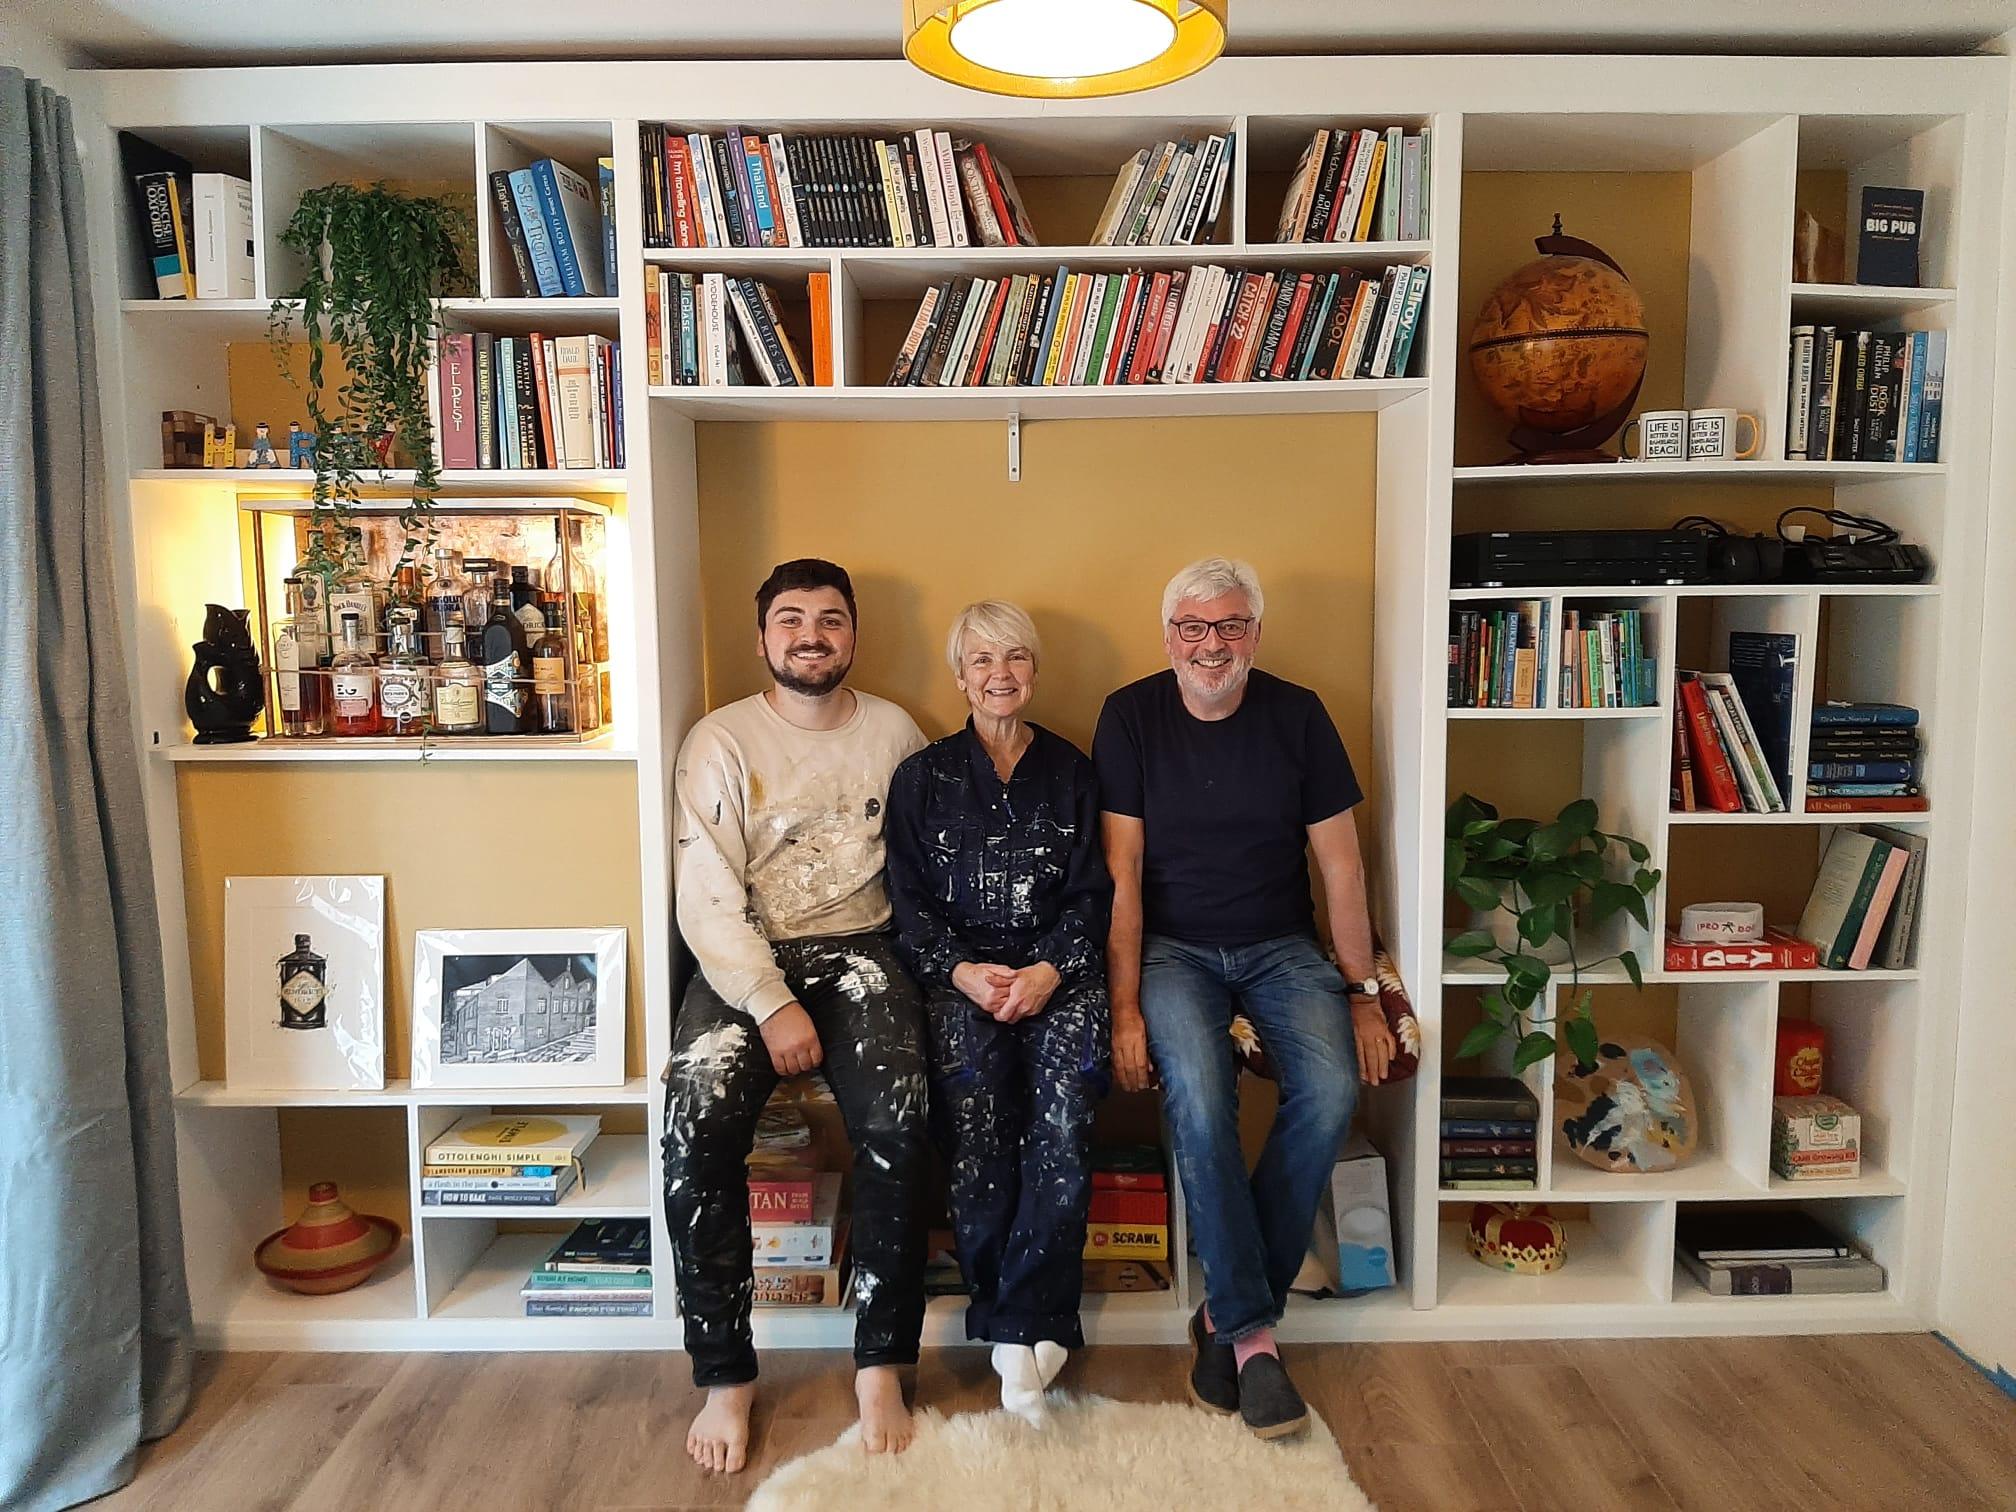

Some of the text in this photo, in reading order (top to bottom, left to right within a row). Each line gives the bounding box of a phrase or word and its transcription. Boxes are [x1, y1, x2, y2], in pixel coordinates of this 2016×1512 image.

[1211, 142, 1220, 154] Anne
[751, 161, 767, 209] Thailand
[941, 148, 958, 206] William Boyd
[1198, 172, 1210, 186] SPOOL
[675, 176, 687, 217] travelling
[1192, 194, 1202, 206] BLUE
[1322, 200, 1331, 219] OUT
[146, 188, 164, 237] OXFORD
[157, 186, 173, 237] CONCISE
[1187, 207, 1198, 226] THREAD
[1311, 193, 1326, 229] BOUNDS
[517, 184, 554, 276] SEA TROLLS
[552, 219, 565, 245] BOYD
[679, 220, 689, 247] alone
[1865, 218, 1916, 235] BIG PUB
[561, 248, 576, 288] WILLIAM
[1042, 286, 1050, 297] THE
[1397, 272, 1408, 296] PAPER
[682, 297, 690, 333] CHASE
[709, 278, 719, 332] WODEHOUSE
[1161, 292, 1179, 332] LIONBOY
[1230, 282, 1258, 340] CATCH-22
[1391, 297, 1403, 316] LION
[1400, 279, 1426, 330] Ellroy
[742, 281, 779, 357] BURIAL RITES
[904, 289, 938, 355] WILLIAM BOYD
[938, 292, 964, 355] JOHN STEINBECK
[1328, 297, 1353, 347] WOOL
[561, 346, 580, 355] ROALD
[1803, 340, 1811, 364] MARTIN
[1874, 339, 1884, 379] PULLMAN
[1881, 345, 1891, 373] PHILIP
[522, 352, 530, 396] SEBASTIAN
[1824, 349, 1833, 381] PRATCHETT
[450, 363, 463, 432] ELDEST
[479, 351, 491, 445] IAIN BANKS TRANSITION
[1869, 387, 1879, 412] DUST
[1877, 385, 1888, 417] BOOK
[1650, 422, 1679, 432] LIFE IS
[1692, 421, 1719, 430] LIFE IS
[203, 420, 396, 469] HARY
[529, 447, 535, 456] IN
[1650, 446, 1679, 454] BEACH
[1690, 444, 1719, 453] BEACH
[1824, 802, 1851, 810] Smith
[1702, 950, 1773, 968] DIY
[438, 1153, 541, 1161] OTTOLENGHI SIMPLE
[434, 1180, 451, 1188] flash
[462, 1180, 473, 1188] the
[460, 1193, 468, 1201] TO
[469, 1193, 486, 1201] BAKE
[750, 1192, 787, 1209] TAN
[1112, 1233, 1160, 1244] SCRAWL
